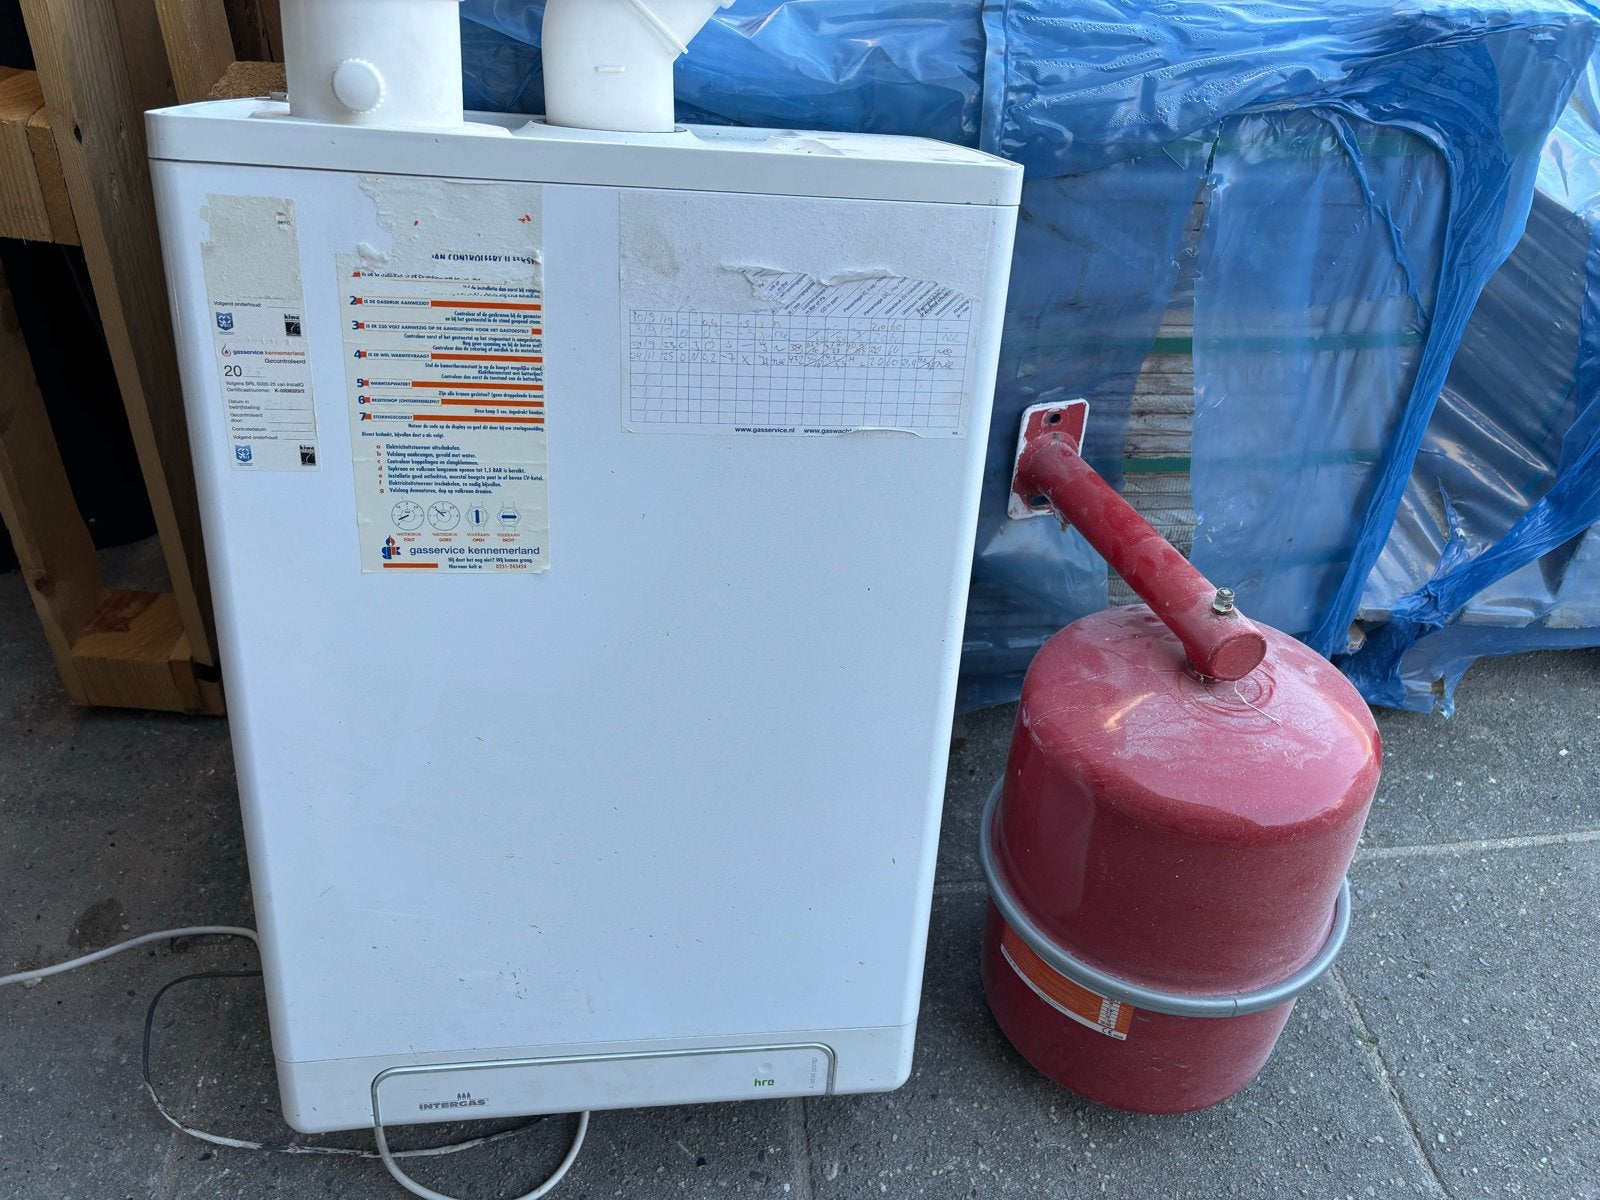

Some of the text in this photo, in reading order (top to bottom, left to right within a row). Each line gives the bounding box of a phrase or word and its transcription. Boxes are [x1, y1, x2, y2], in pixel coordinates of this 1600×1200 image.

[350, 296, 357, 305] 2
[352, 320, 359, 330] 3
[354, 350, 361, 359] 4
[224, 365, 242, 377] 20
[357, 378, 364, 387] 5
[358, 396, 365, 404] 6
[360, 412, 366, 421] 7
[410, 546, 540, 555] gasservice kennemerland
[754, 1078, 775, 1086] hre
[419, 1099, 486, 1110] INTERGAS
